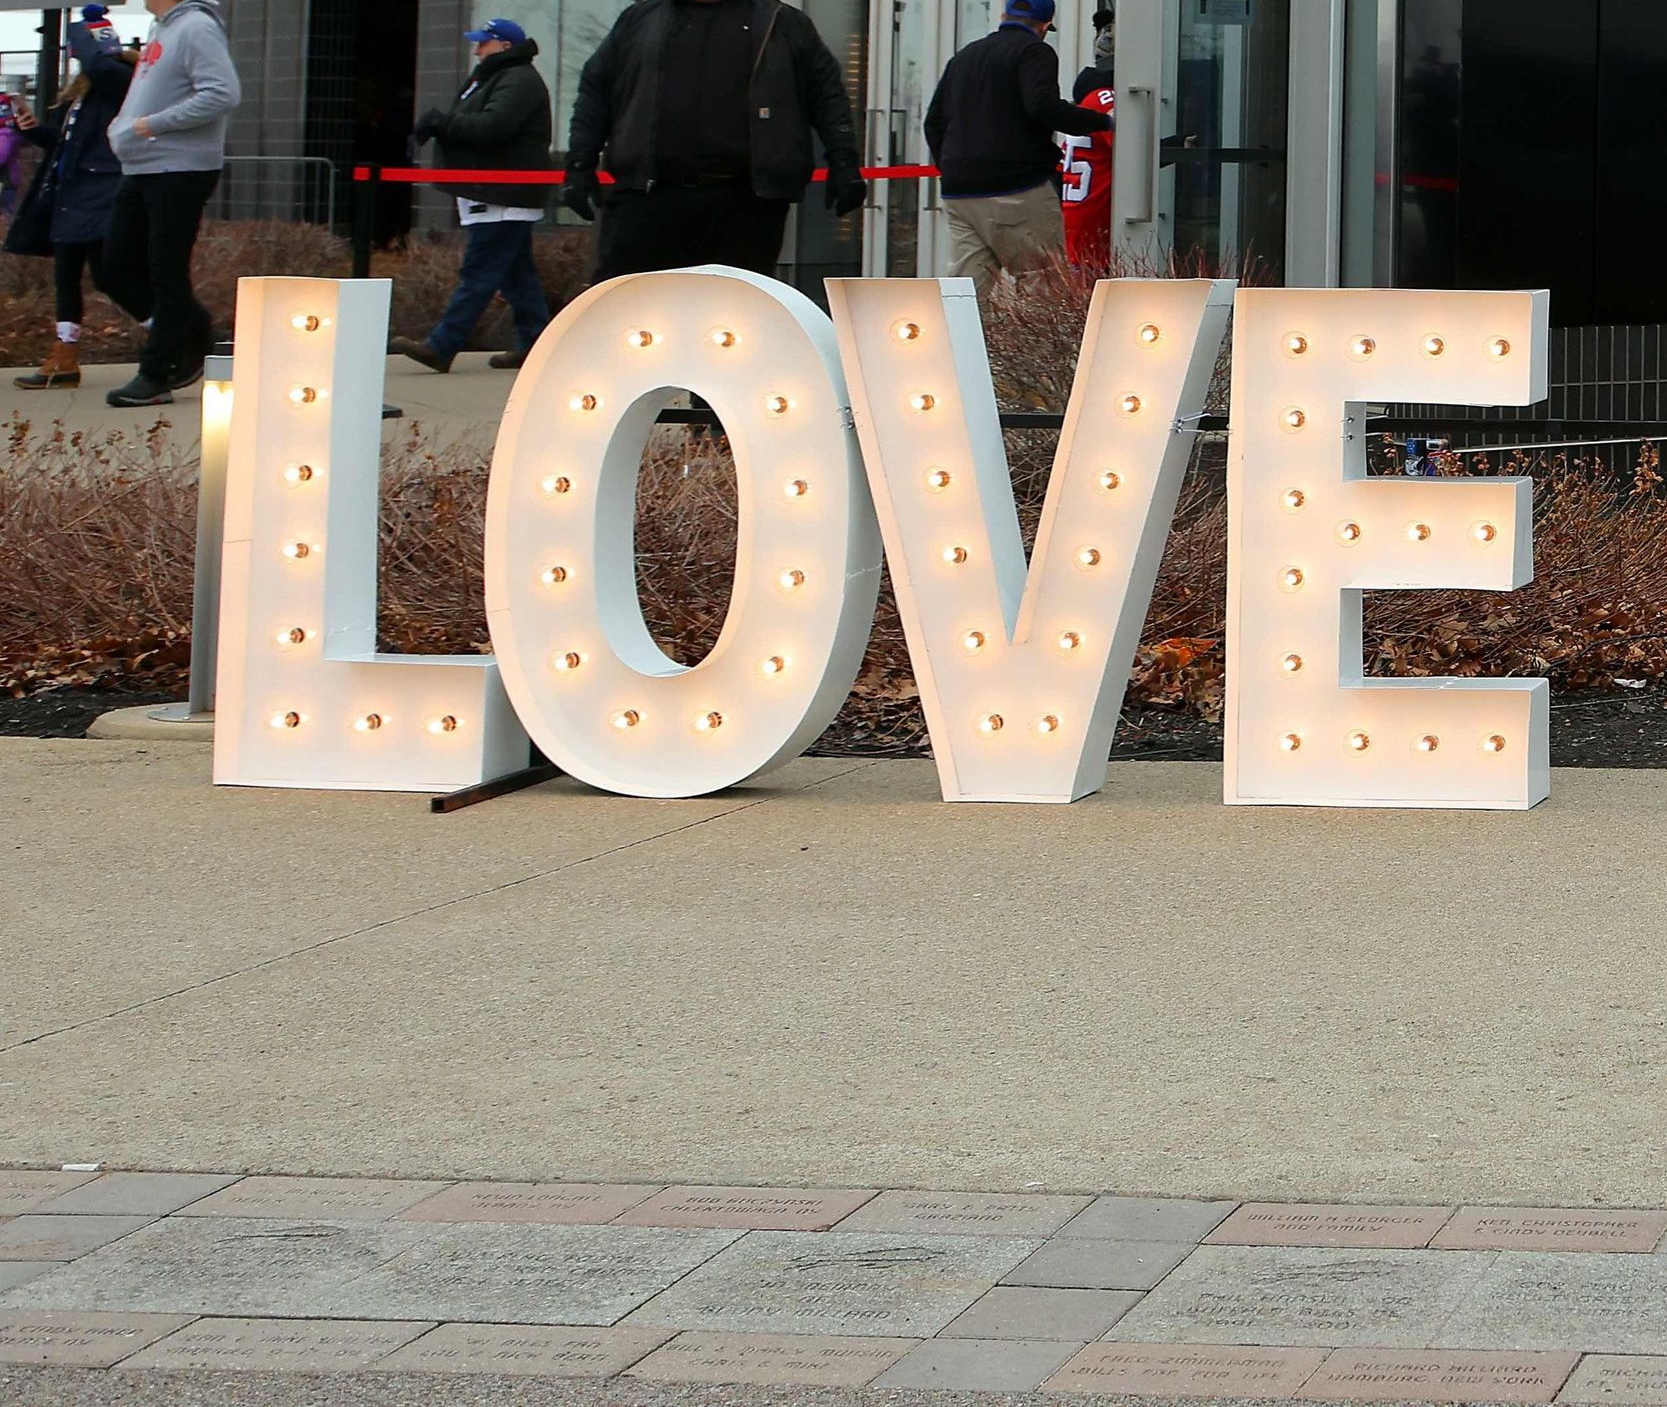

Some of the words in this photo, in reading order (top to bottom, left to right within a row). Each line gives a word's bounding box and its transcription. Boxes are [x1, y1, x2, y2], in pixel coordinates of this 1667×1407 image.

[213, 266, 1552, 810] LOVE
[1246, 1214, 1319, 1222] WILLIAM
[1440, 1374, 1485, 1384] NEW
